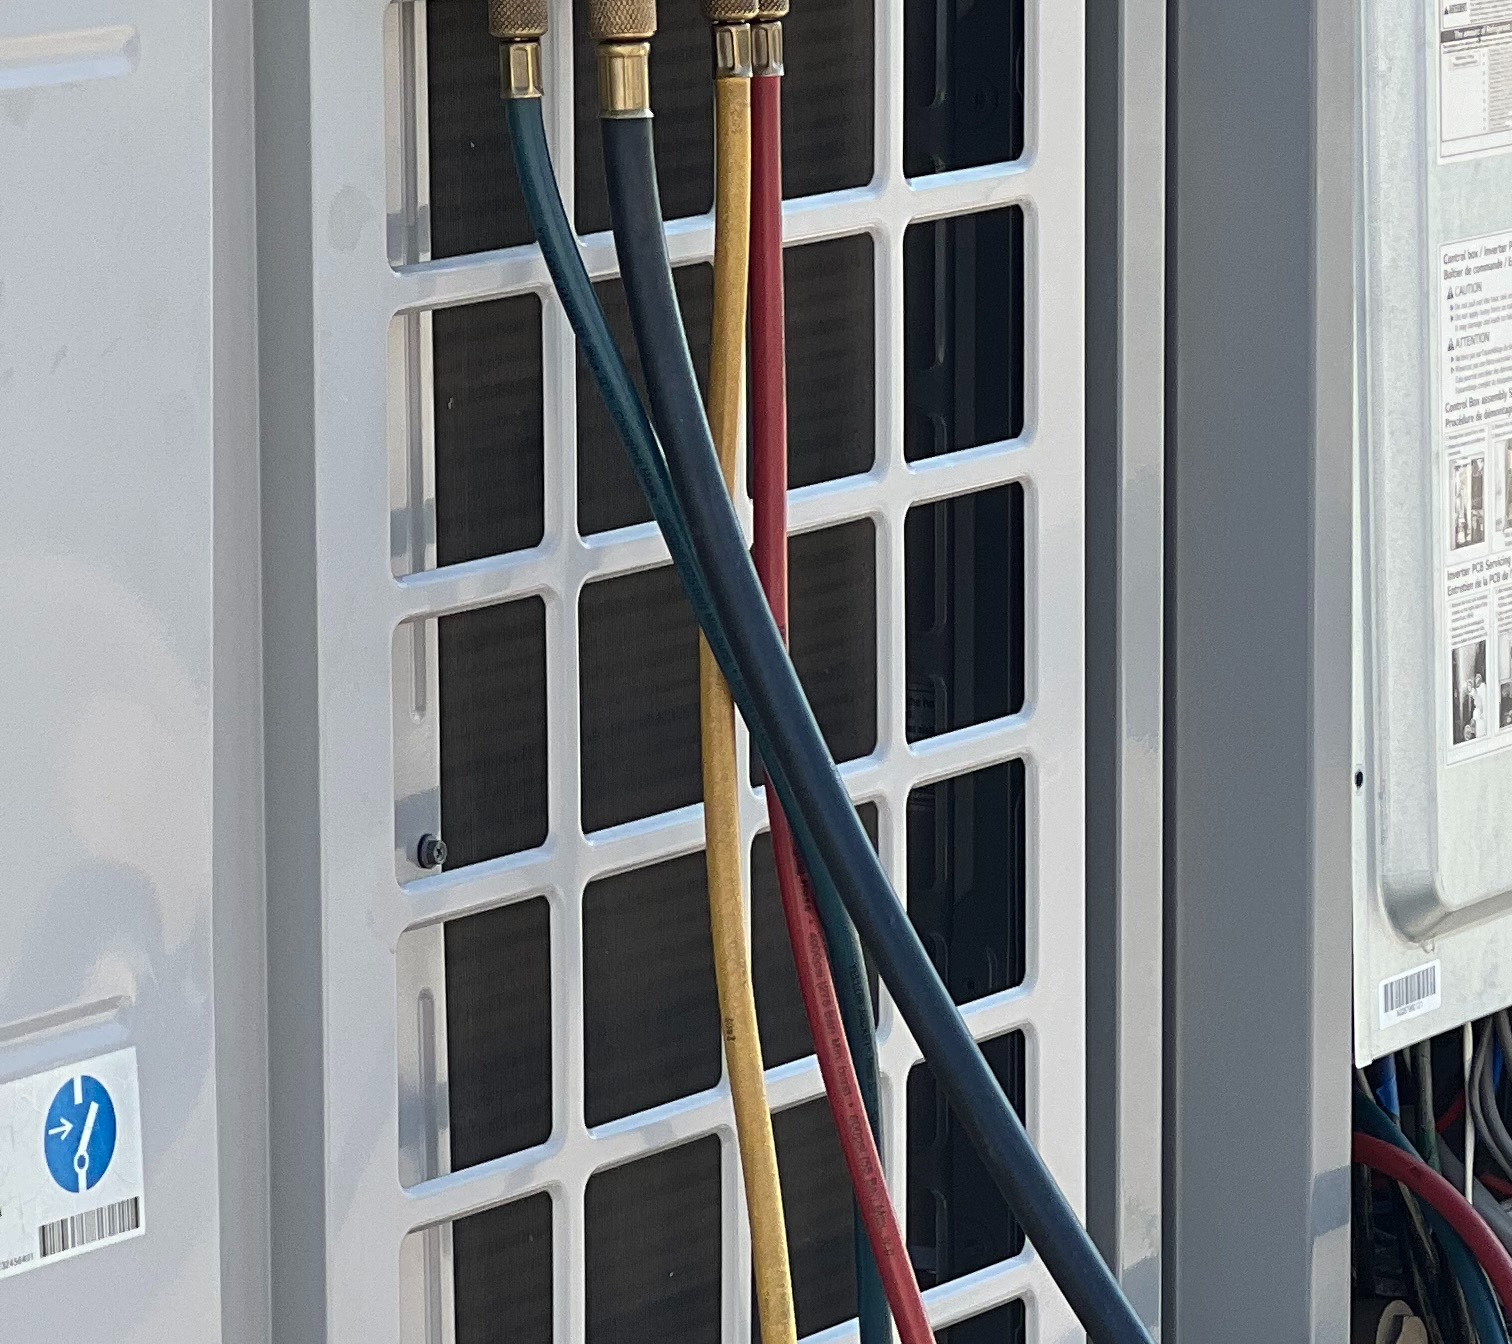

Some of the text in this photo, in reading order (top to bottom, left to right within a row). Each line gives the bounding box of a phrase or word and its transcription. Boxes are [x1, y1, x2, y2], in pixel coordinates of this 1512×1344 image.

[1443, 250, 1465, 264] Control
[1467, 250, 1478, 259] box
[1455, 282, 1482, 297] CAUTION
[1455, 332, 1490, 348] ATTENTION
